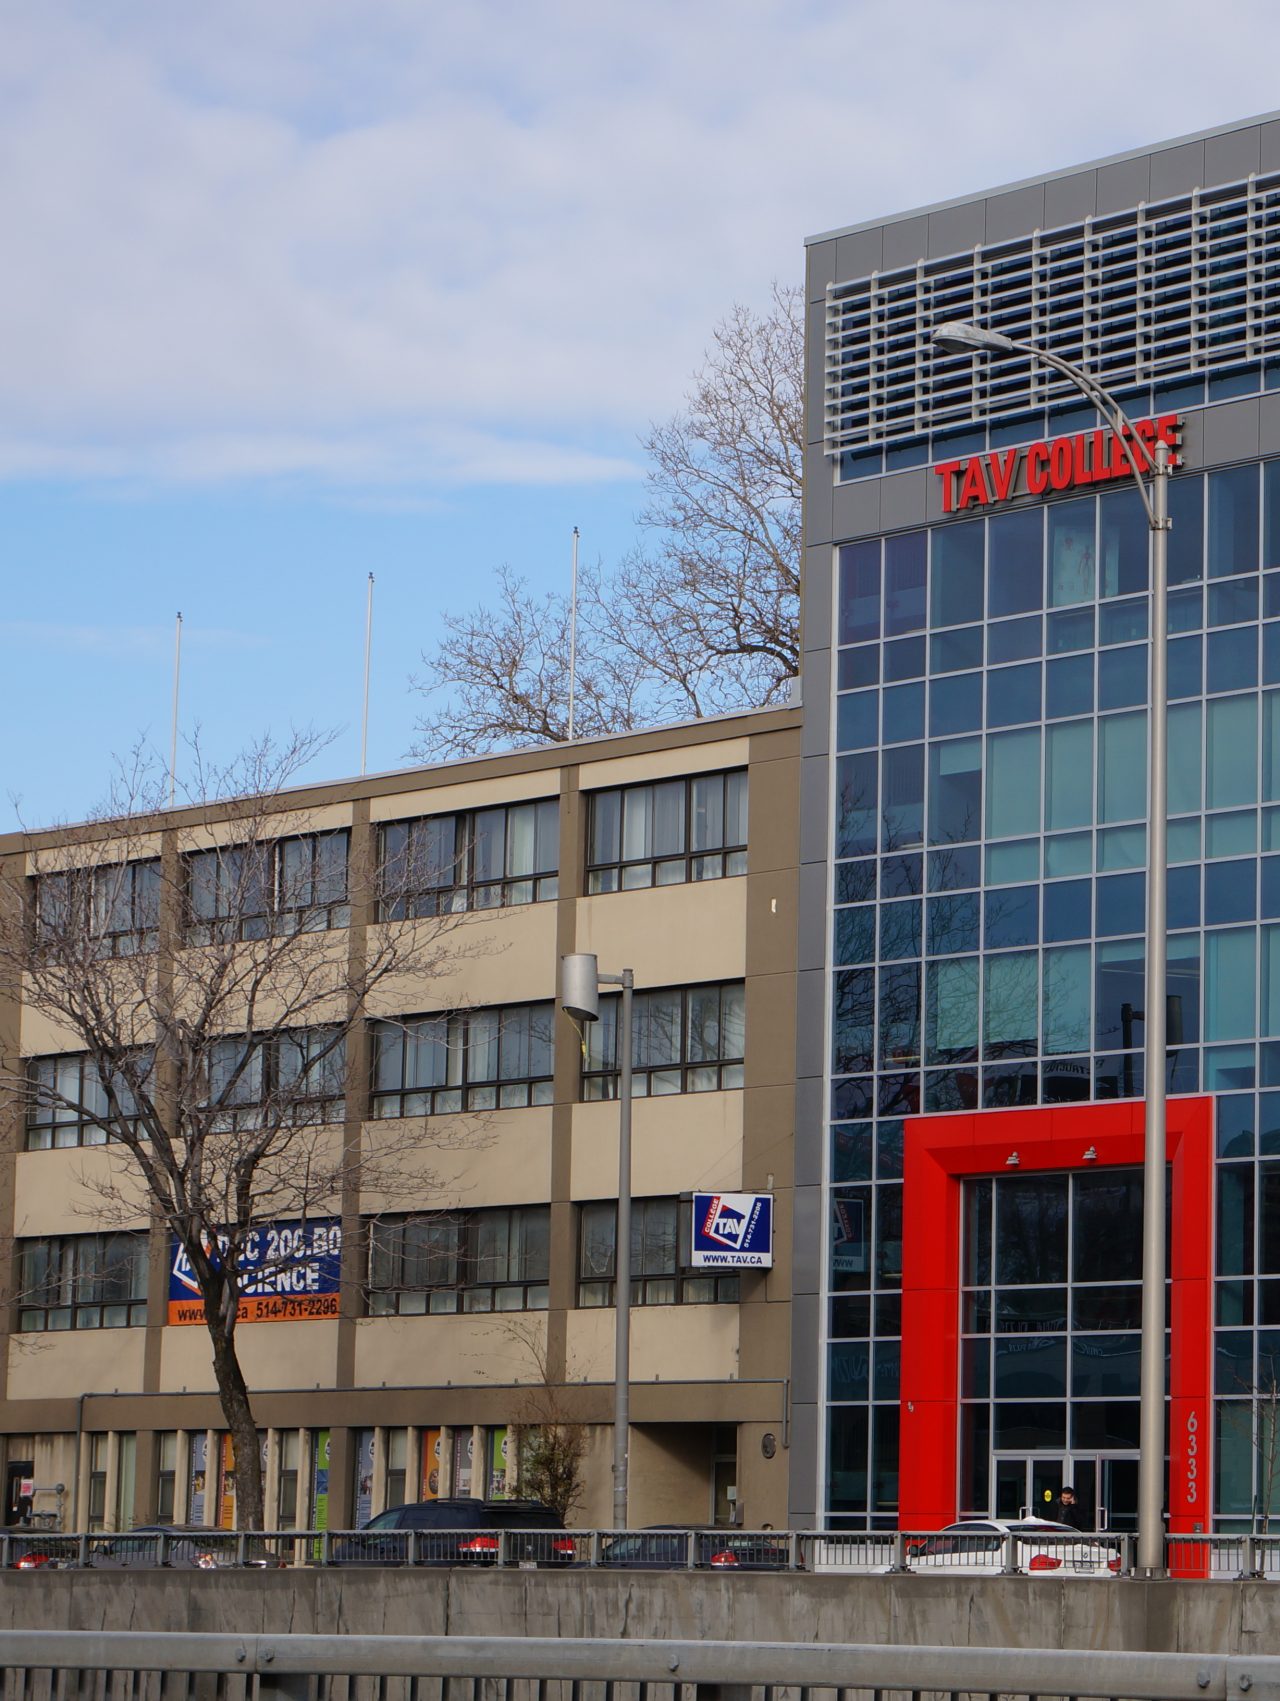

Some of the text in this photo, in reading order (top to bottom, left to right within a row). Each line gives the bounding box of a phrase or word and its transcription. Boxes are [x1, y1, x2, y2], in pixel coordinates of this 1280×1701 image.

[935, 414, 1182, 513] TAV COLLEGE
[718, 1218, 746, 1235] TAV
[703, 1254, 763, 1265] WWW.TAV.CA
[256, 1298, 338, 1319] 514-731-2296
[1186, 1410, 1198, 1504] 6333
